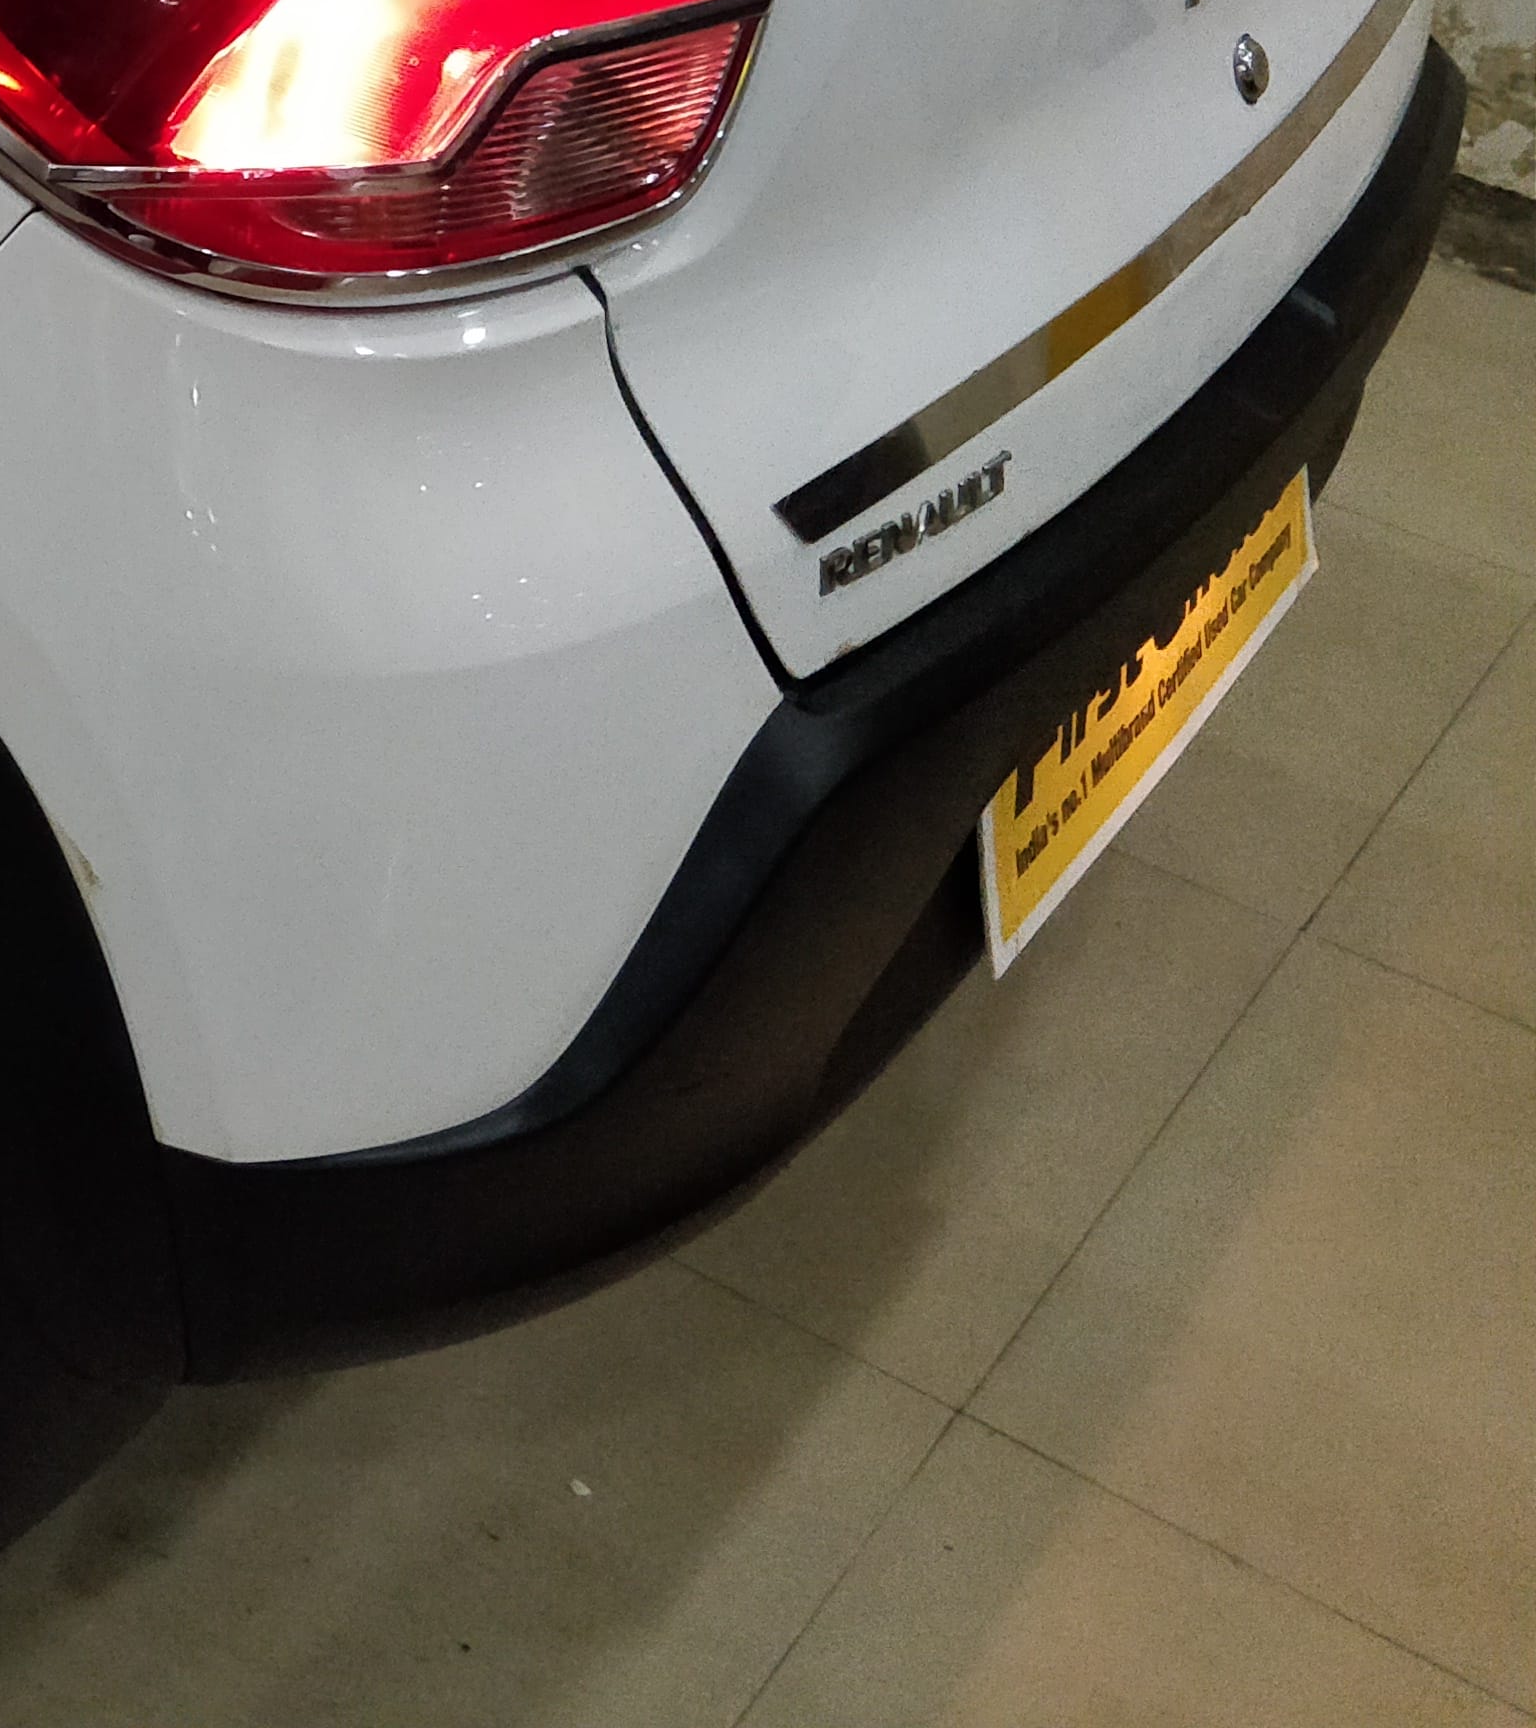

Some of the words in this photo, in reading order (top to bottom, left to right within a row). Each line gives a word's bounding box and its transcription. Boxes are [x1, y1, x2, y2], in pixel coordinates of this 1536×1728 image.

[819, 450, 1012, 597] RENAULT
[1016, 811, 1059, 879] India's
[1157, 631, 1203, 708] Certified
[1204, 596, 1229, 650] Used
[1230, 578, 1247, 615] Car
